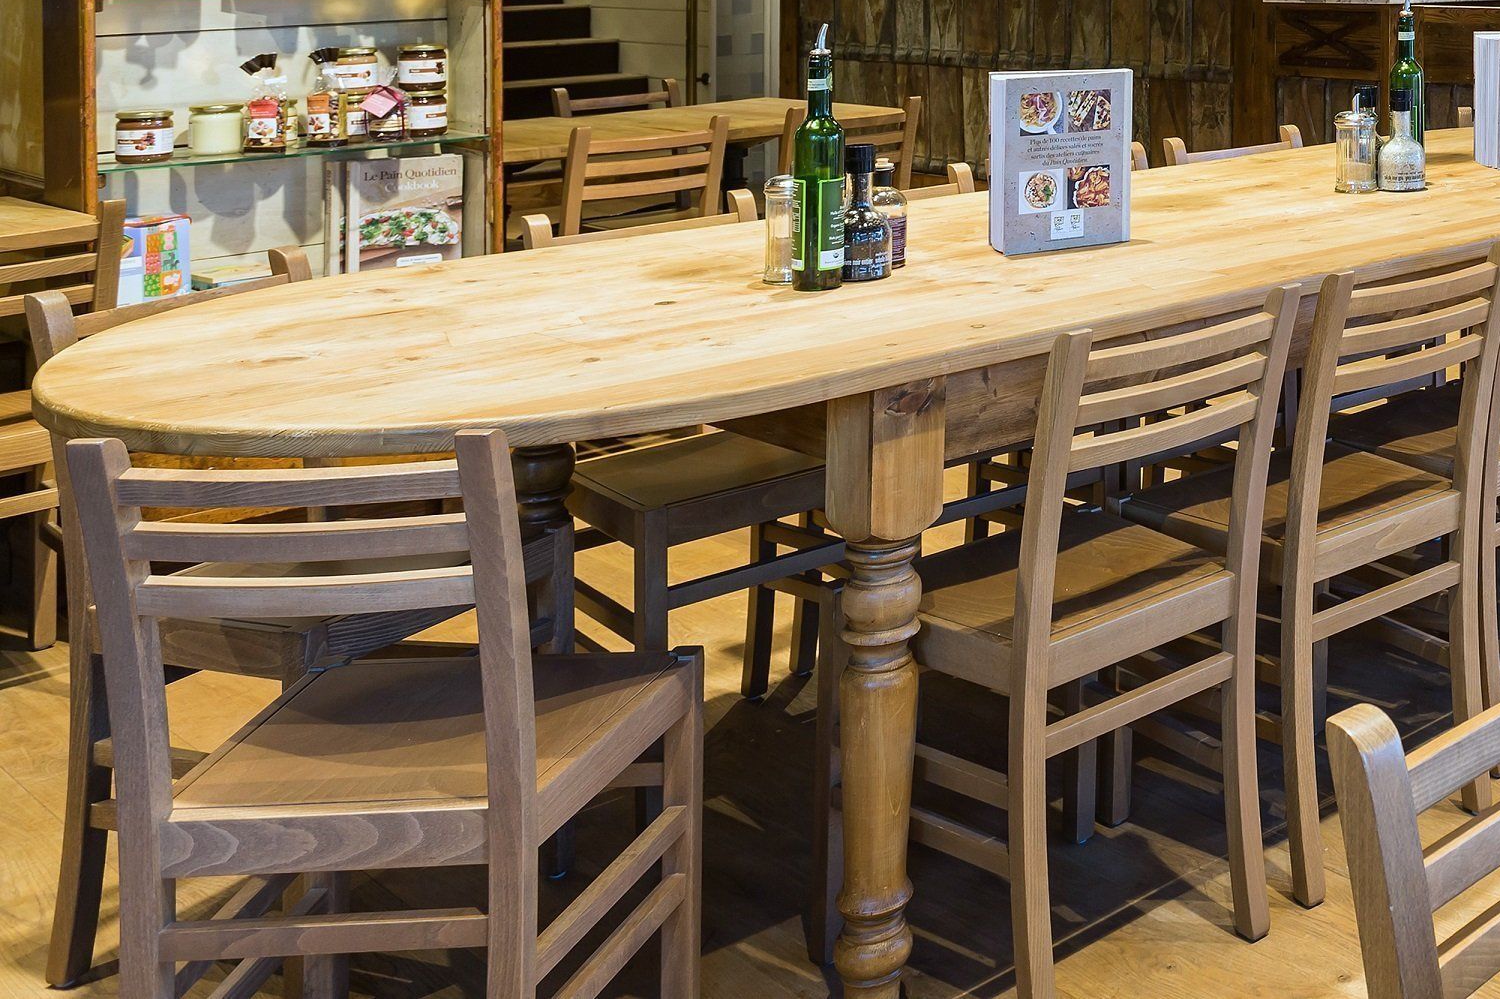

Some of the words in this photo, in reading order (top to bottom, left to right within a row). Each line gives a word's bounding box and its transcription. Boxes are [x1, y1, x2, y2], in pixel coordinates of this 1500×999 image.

[364, 172, 377, 181] Le
[380, 170, 403, 181] Pain
[405, 167, 457, 180] Quotidien
[384, 180, 439, 193] Cookbook
